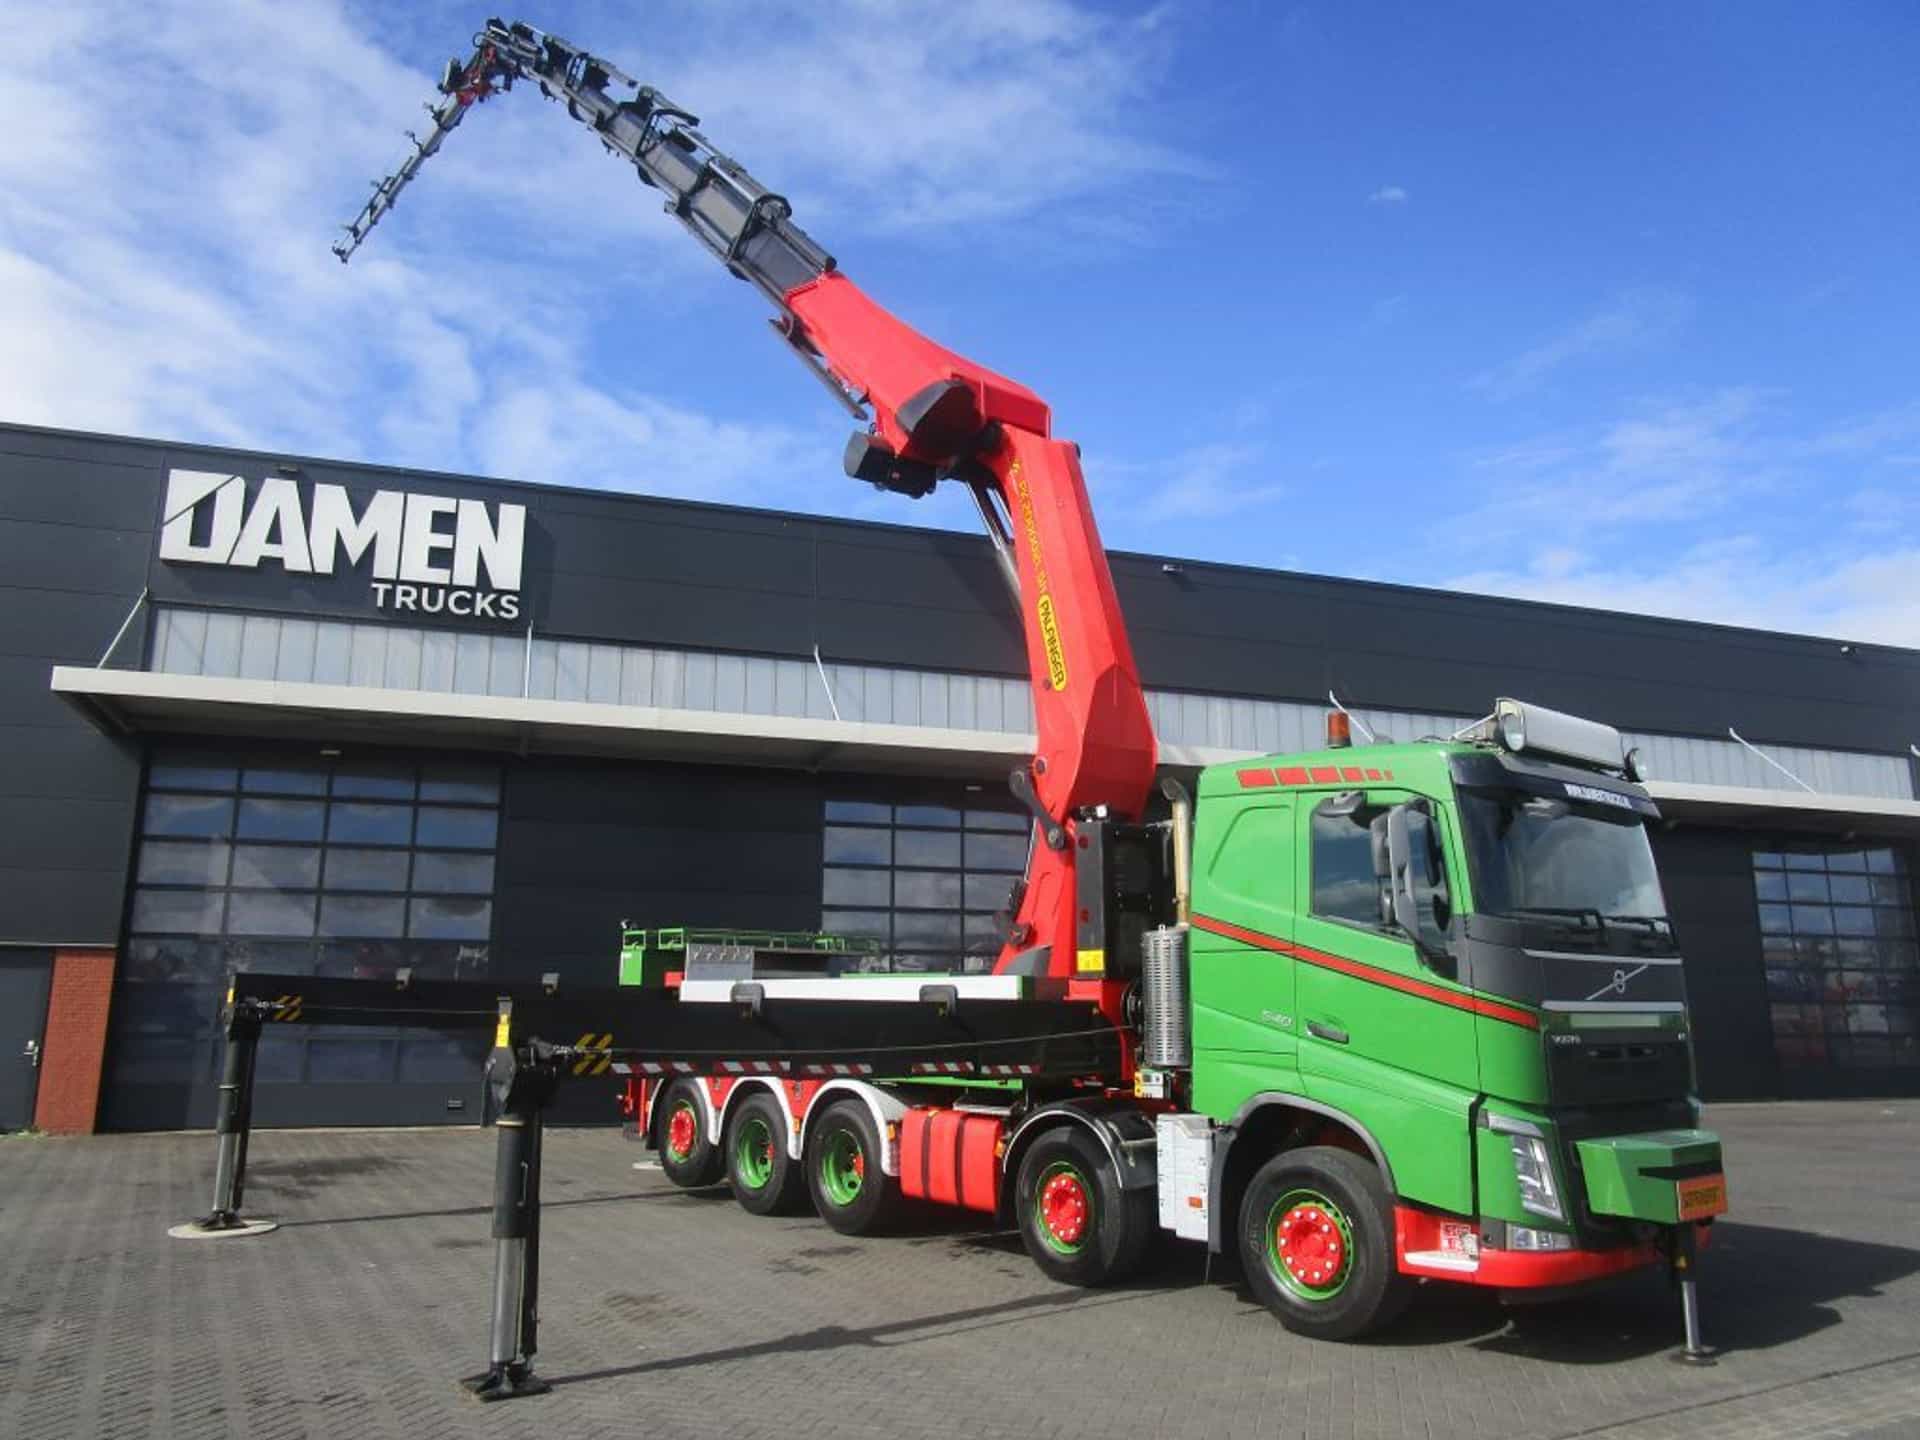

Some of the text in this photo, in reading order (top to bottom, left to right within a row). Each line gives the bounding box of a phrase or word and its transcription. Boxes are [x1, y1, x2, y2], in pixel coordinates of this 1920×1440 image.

[159, 469, 526, 591] DAMEN
[371, 582, 520, 619] TRUCKS
[1039, 600, 1066, 687] PALFINGER
